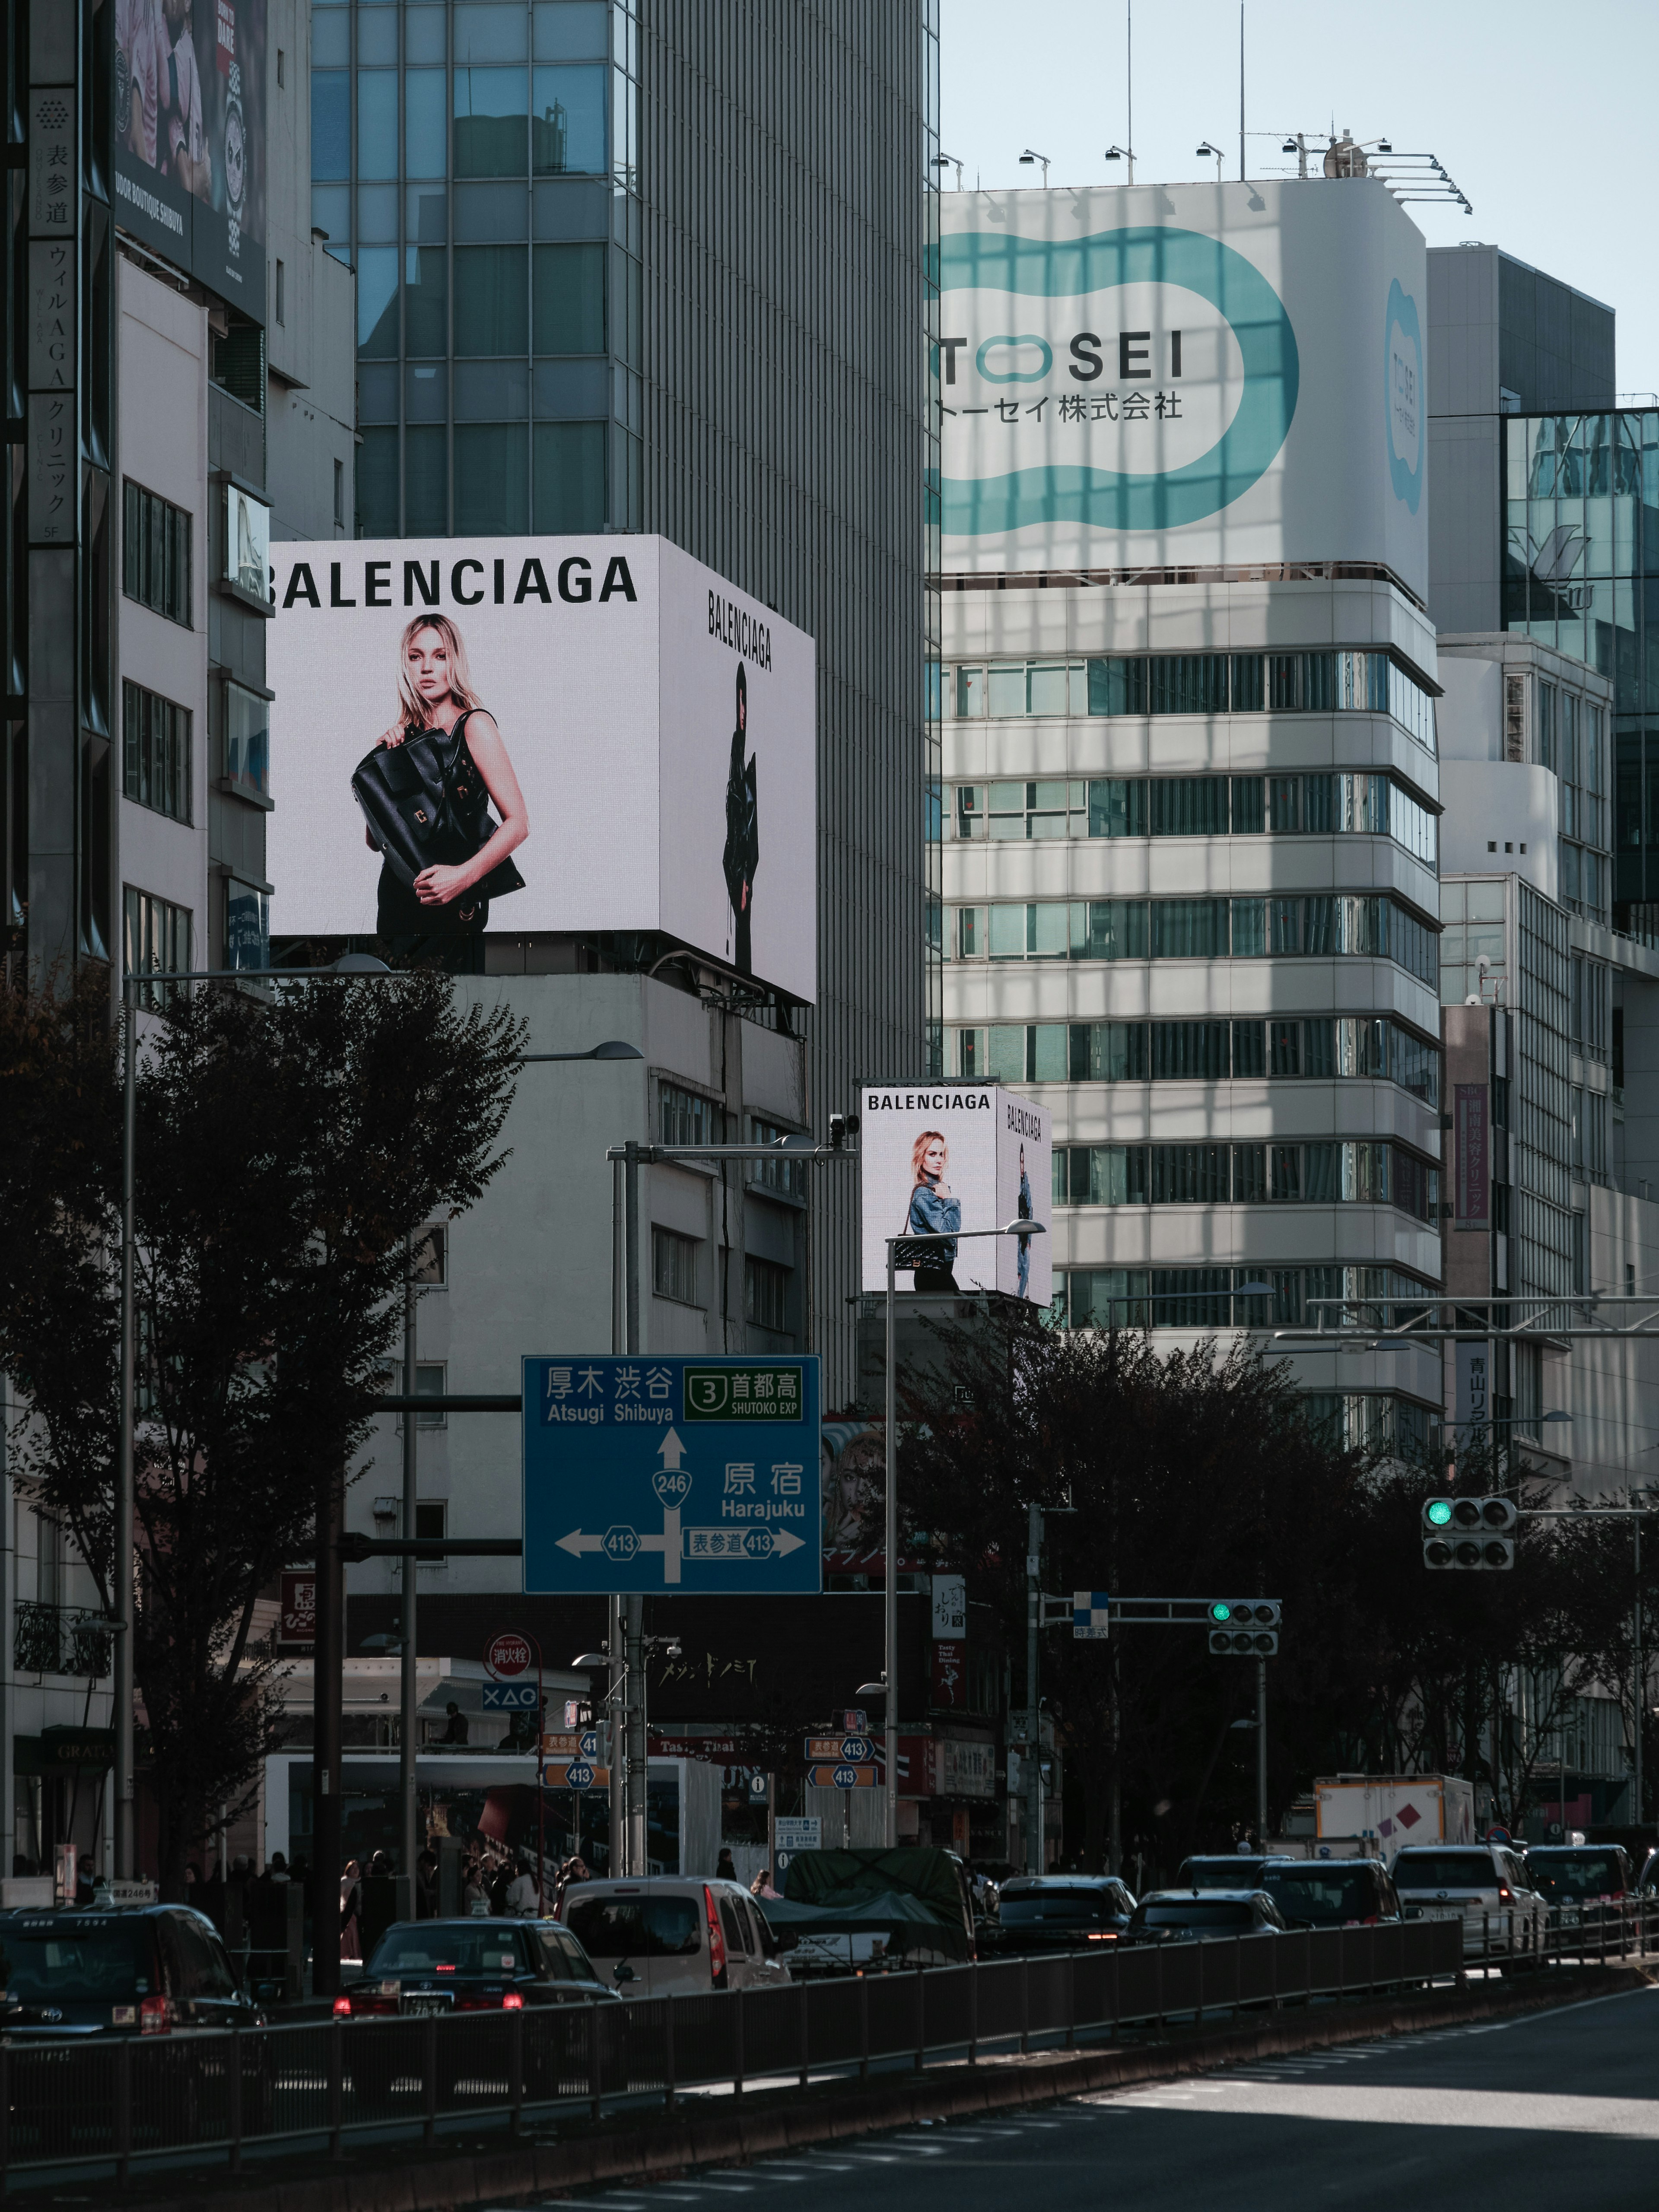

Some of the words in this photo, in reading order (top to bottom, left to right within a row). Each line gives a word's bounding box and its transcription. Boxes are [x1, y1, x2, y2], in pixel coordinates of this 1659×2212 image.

[218, 18, 234, 54] DARE
[47, 145, 68, 223] 表参道
[115, 171, 131, 201] UDOR
[132, 183, 159, 220] BOUTIQUE
[160, 203, 183, 236] SHIBUYA
[48, 247, 67, 385] ウィルAGA
[934, 391, 1182, 426] トーセイ株式会社
[47, 401, 65, 514] クリニック
[44, 527, 58, 537] 5F
[709, 589, 771, 673] BALENCIAGA
[1460, 1086, 1481, 1095] SBC
[869, 1094, 990, 1110] BALENCIAGA
[1008, 1104, 1041, 1143] BALENCIAGA
[1469, 1100, 1482, 1217] 湘南美容クリニック
[547, 1366, 604, 1400] 厚木
[614, 1366, 672, 1400] 渋谷
[702, 1382, 716, 1404] 3
[731, 1373, 797, 1398] 首都高
[547, 1404, 604, 1424] Atsugi
[614, 1404, 673, 1424] Shibuya
[731, 1402, 776, 1414] SHUTOKO
[780, 1402, 797, 1414] EXP
[657, 1475, 686, 1493] 246
[723, 1462, 804, 1495] 原宿
[722, 1500, 805, 1520] Harajuku
[608, 1536, 634, 1551] 413
[693, 1533, 742, 1553] 表参道
[746, 1536, 771, 1551] 413
[935, 1592, 949, 1627] しおり
[1075, 1627, 1108, 1638] 時差式
[494, 1647, 527, 1665] 消火栓
[549, 1737, 577, 1748] 表参道
[583, 1738, 596, 1751] 41
[703, 1741, 734, 1752] Thai
[815, 1742, 839, 1751] 表参道
[844, 1743, 863, 1756] 413
[569, 1768, 590, 1782] 413
[836, 1770, 854, 1783] 413
[114, 1889, 151, 1898] 国道246号
